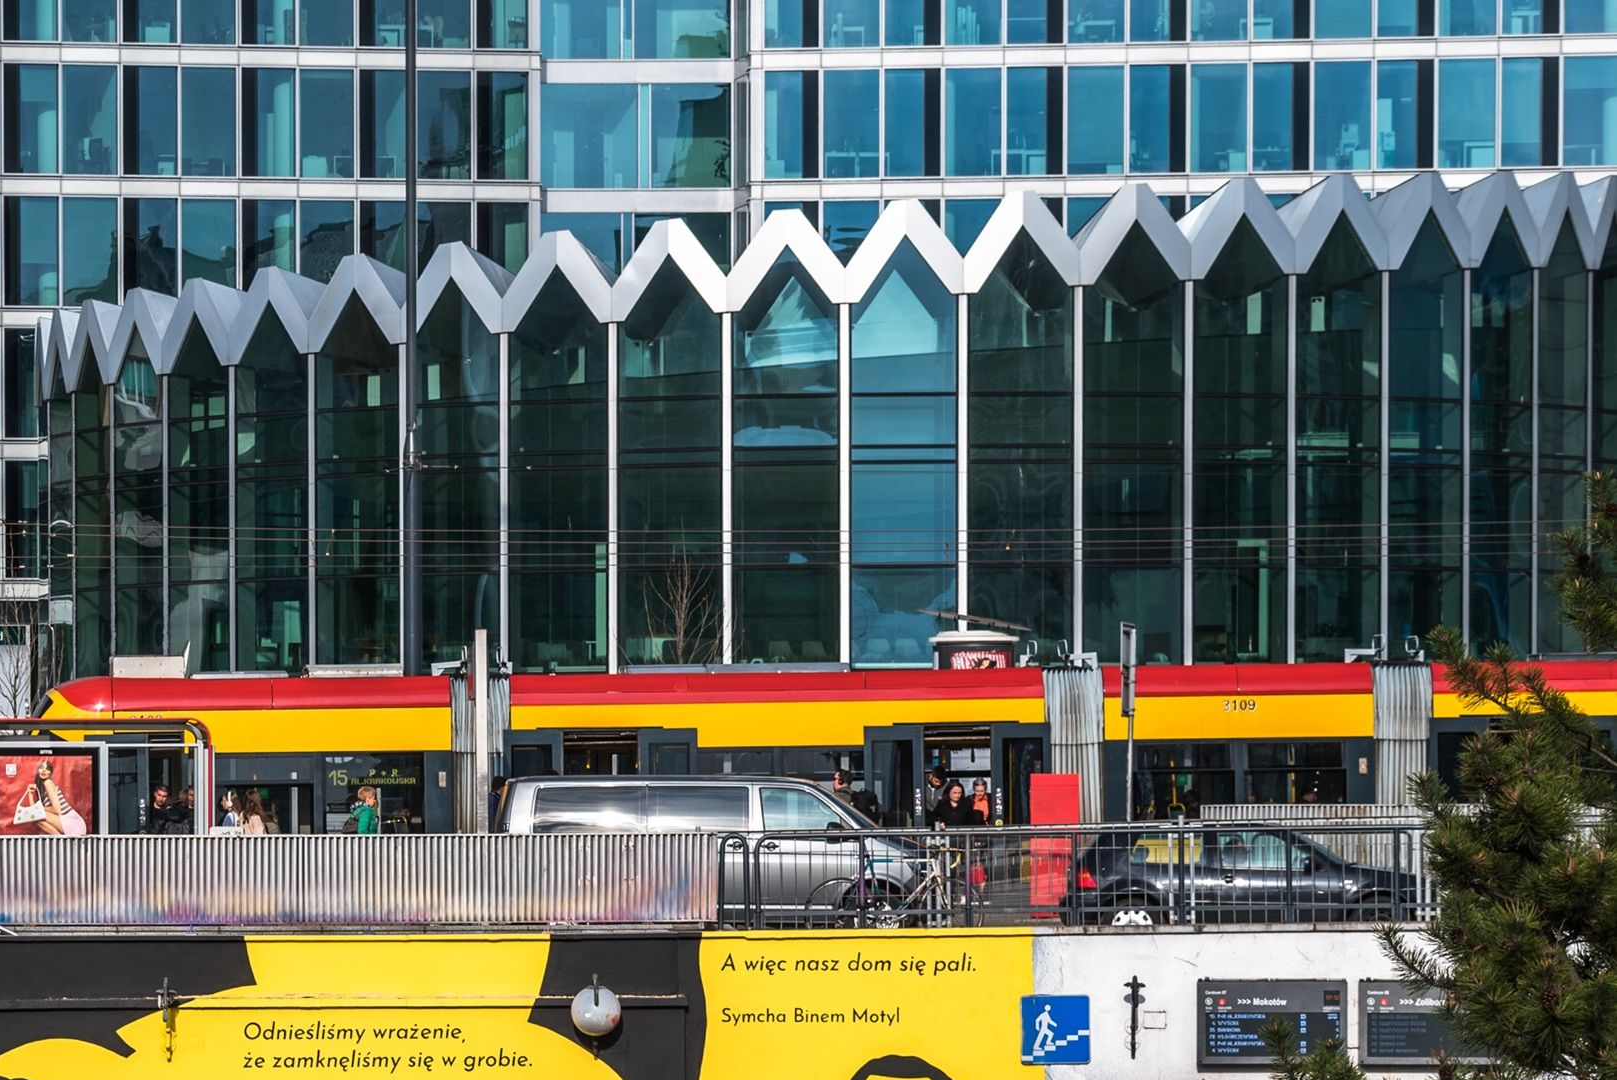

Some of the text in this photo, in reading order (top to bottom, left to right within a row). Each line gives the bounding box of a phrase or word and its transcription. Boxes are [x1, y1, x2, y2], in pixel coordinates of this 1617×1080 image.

[1222, 699, 1256, 712] 3109
[328, 769, 348, 786] 15
[721, 952, 975, 976] A więc nasz dom się pali.
[1253, 997, 1287, 1005] Mokotów
[722, 1007, 899, 1026] Symcha Binem Motyl
[244, 1021, 465, 1044] Odnieśliśmy wrażenie,
[244, 1048, 532, 1073] że zamknęliśmy się w grobie.
